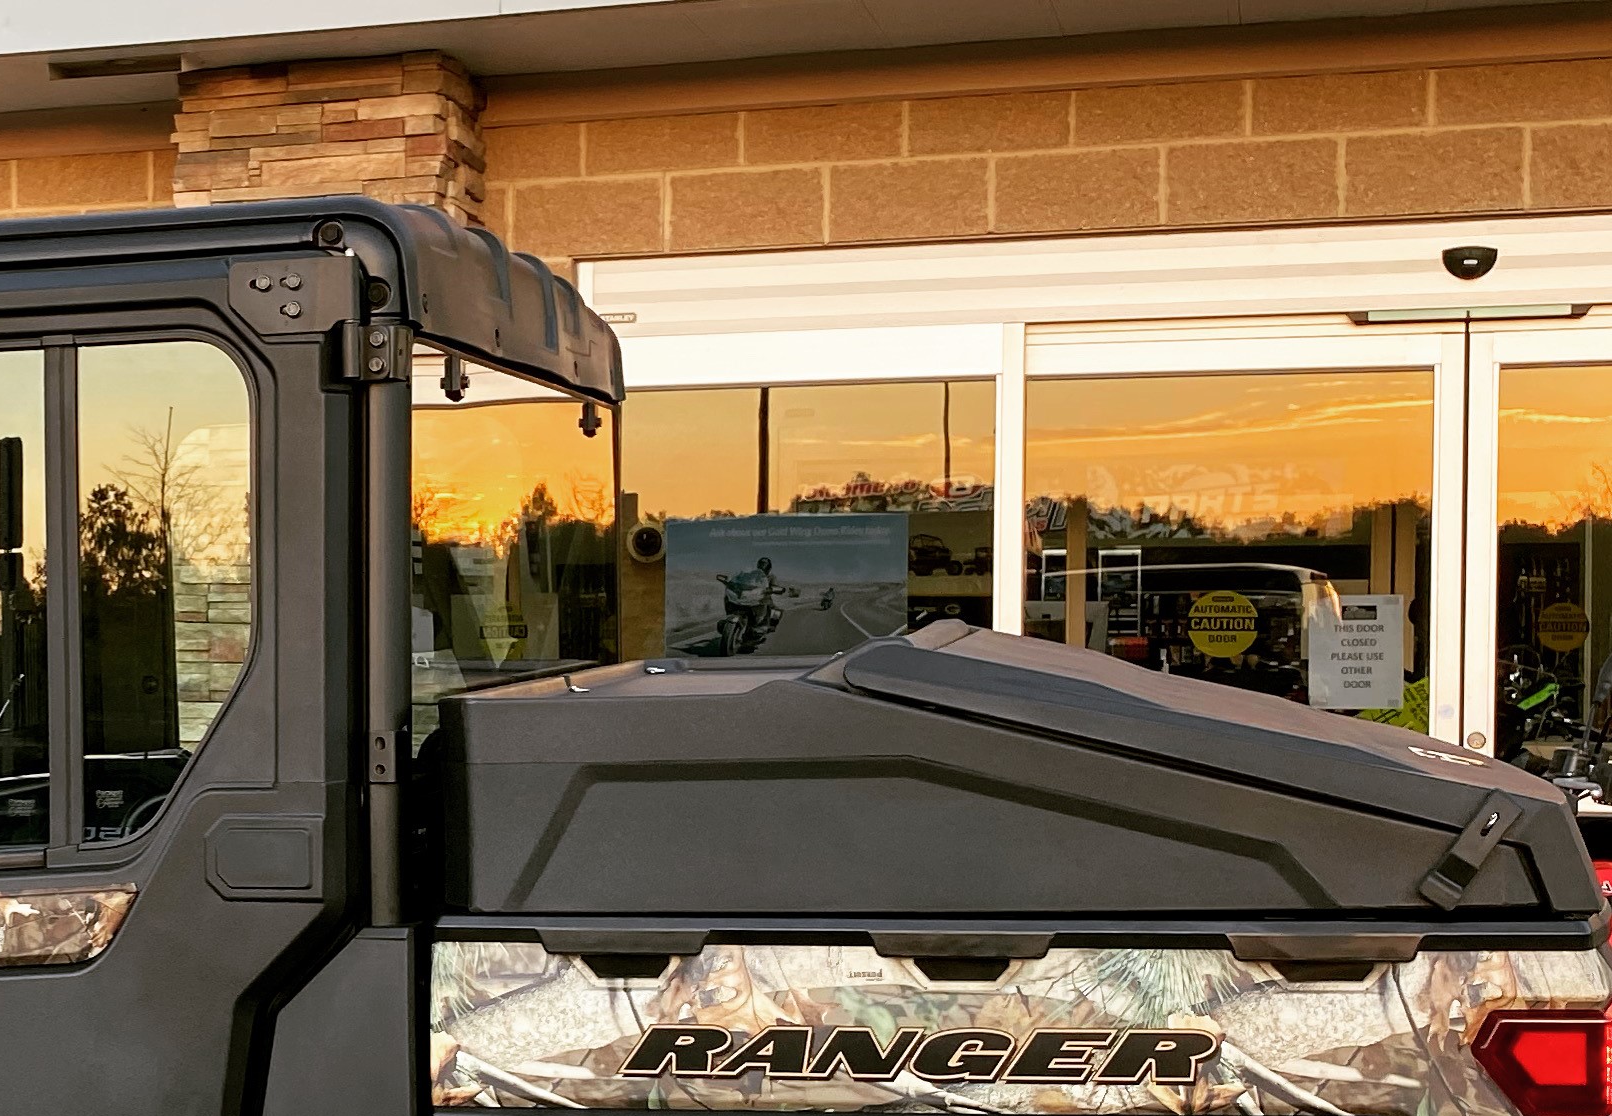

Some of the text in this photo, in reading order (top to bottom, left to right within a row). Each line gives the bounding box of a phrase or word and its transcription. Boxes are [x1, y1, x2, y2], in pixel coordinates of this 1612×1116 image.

[1194, 604, 1253, 613] AUTOMATIC
[1191, 618, 1255, 630] CAUTION
[1334, 624, 1385, 632] THIS DOOR
[1341, 638, 1377, 646] CLOSED
[1331, 652, 1384, 660] PLEASE USE
[1341, 666, 1373, 674] OTHER
[1344, 680, 1372, 688] DOOR
[619, 1023, 1222, 1084] RANGER
